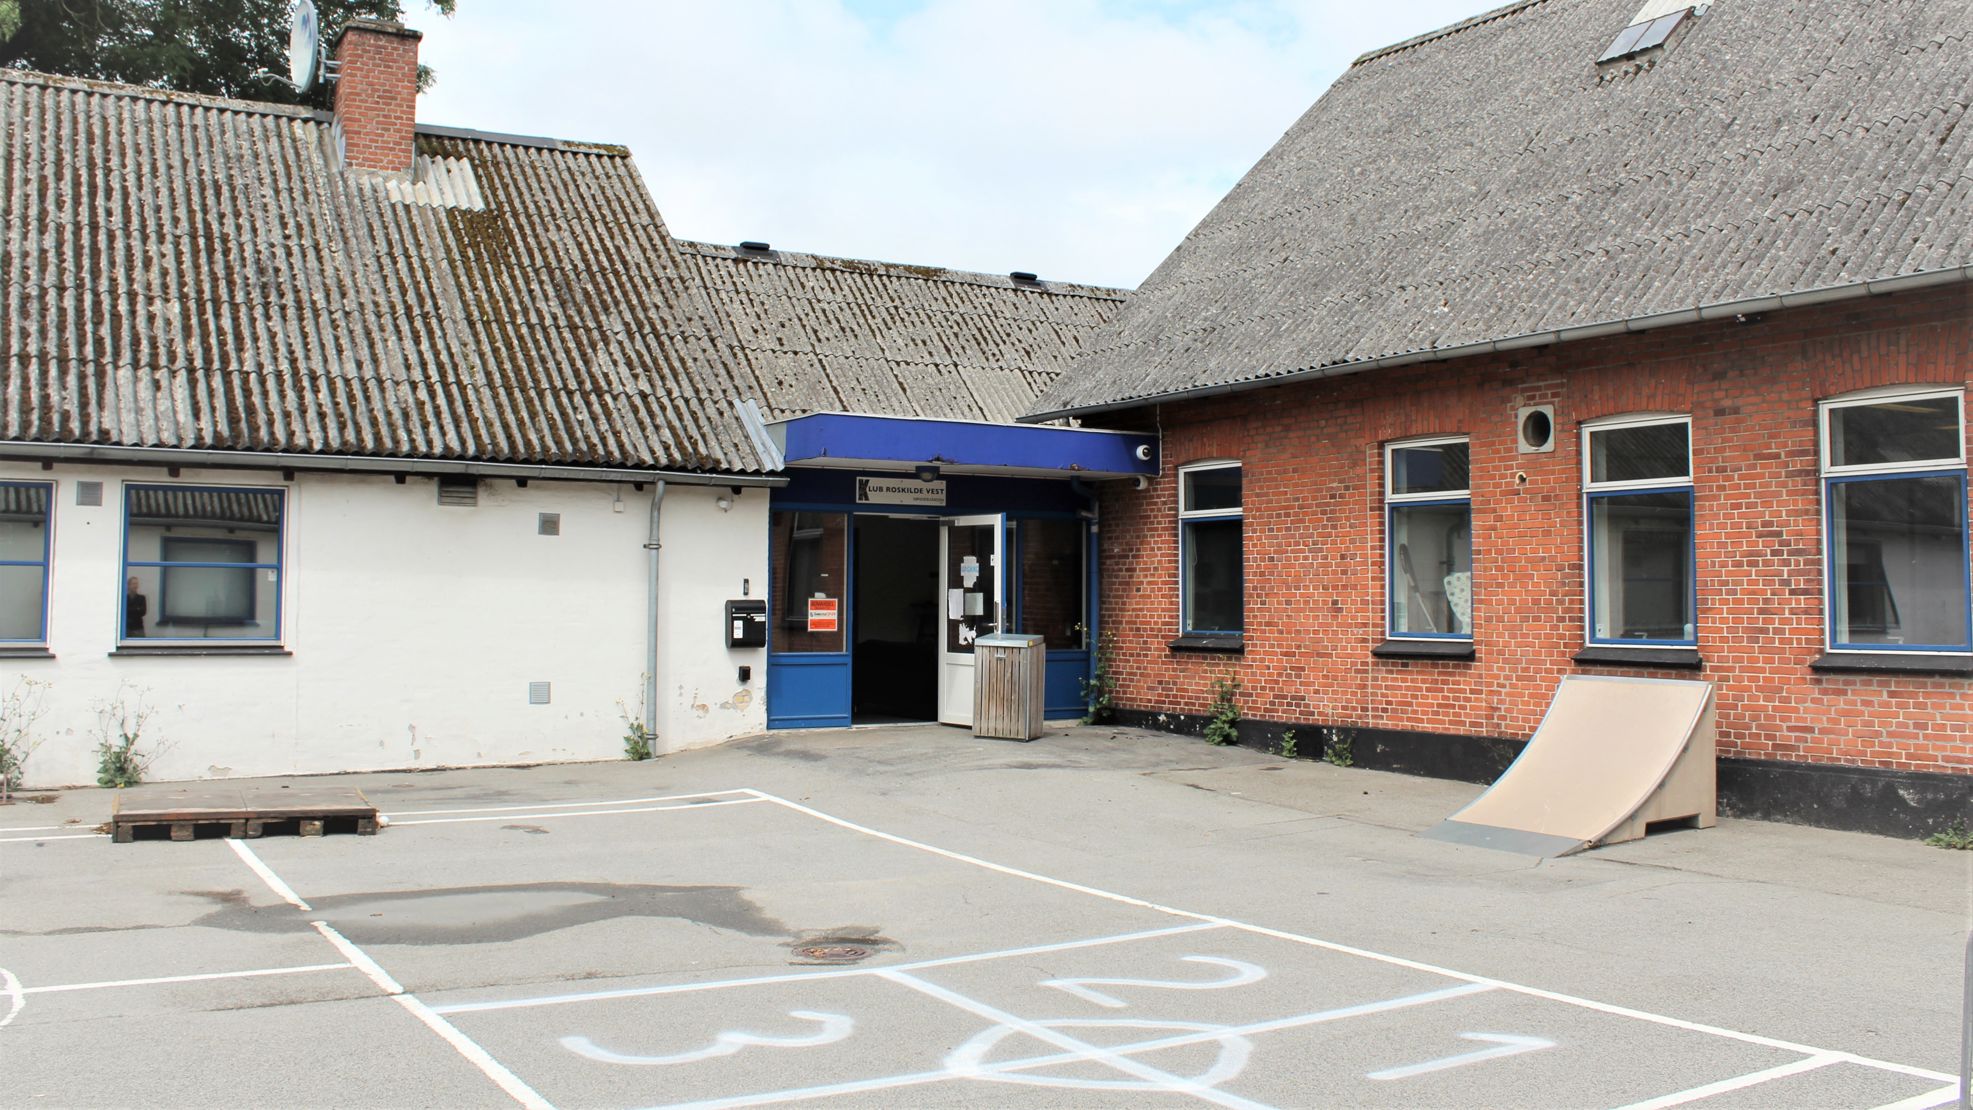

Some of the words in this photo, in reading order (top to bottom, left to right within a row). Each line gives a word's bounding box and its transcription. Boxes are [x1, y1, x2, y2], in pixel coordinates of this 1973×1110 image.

[858, 479, 884, 501] KLUB
[886, 486, 924, 494] ROSKILDE
[559, 1009, 855, 1065] 3
